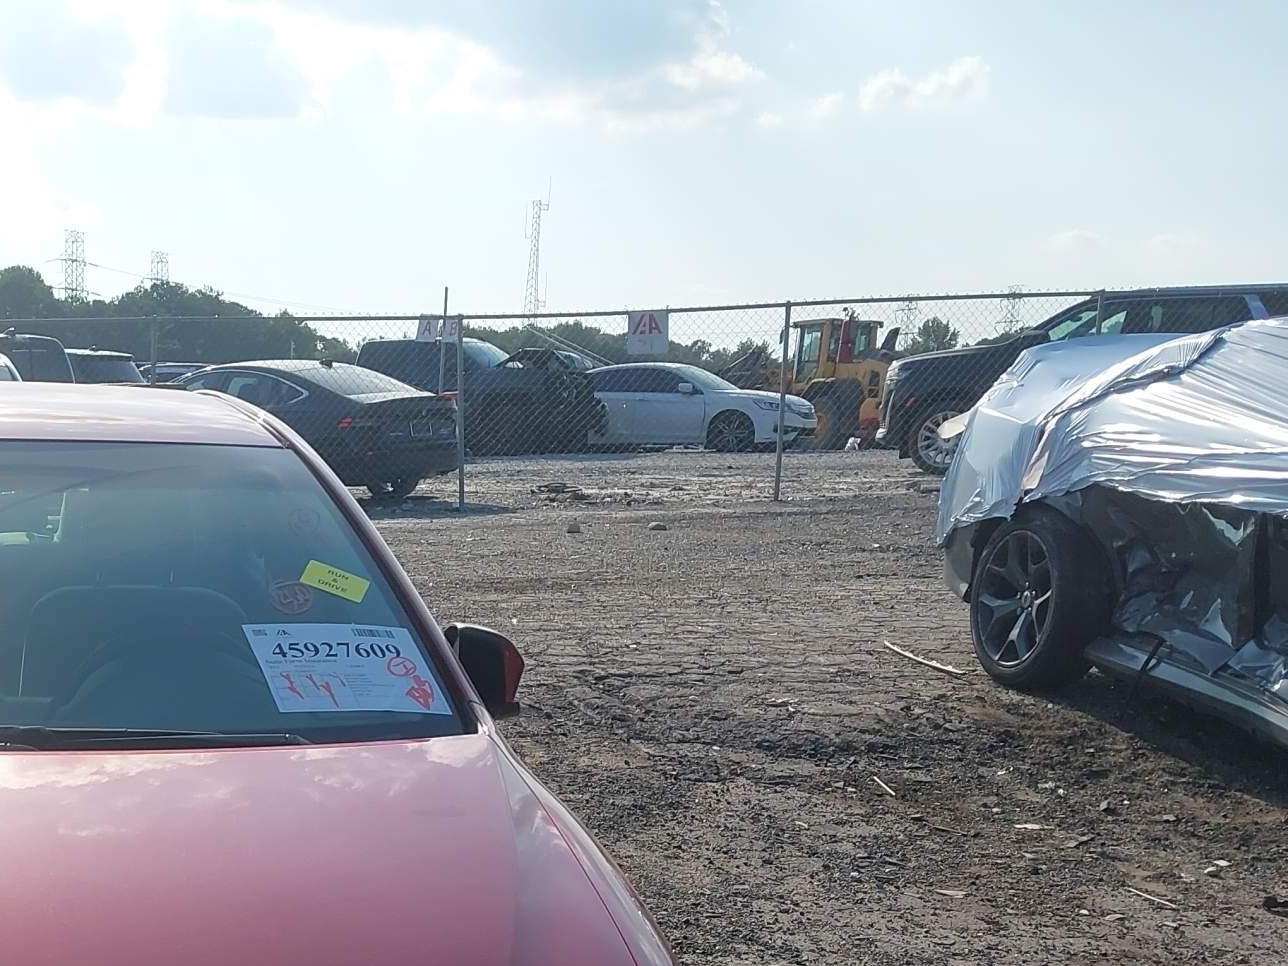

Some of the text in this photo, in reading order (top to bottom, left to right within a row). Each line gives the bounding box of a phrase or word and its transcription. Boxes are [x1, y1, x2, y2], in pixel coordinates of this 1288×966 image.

[423, 320, 432, 336] A
[450, 320, 458, 337] B
[327, 569, 349, 581] RUN
[317, 578, 348, 593] DRIVE
[272, 642, 401, 659] 45927609
